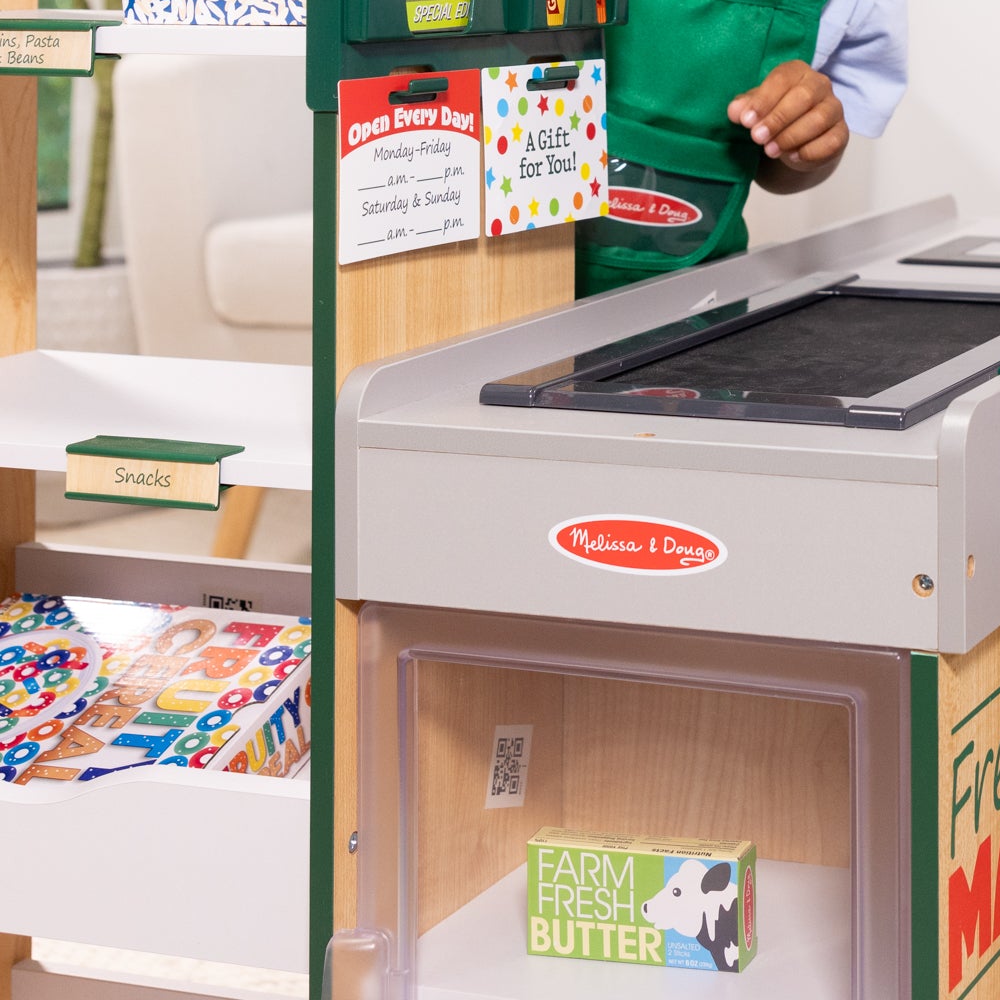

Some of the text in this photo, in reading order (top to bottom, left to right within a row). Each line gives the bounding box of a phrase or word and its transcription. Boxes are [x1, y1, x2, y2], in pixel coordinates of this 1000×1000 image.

[413, 2, 453, 23] SPECIAL
[0, 33, 60, 49] ins, Pasta
[7, 50, 45, 65] Beans
[348, 105, 474, 146] Open Every Day!
[525, 126, 570, 152] A Gift
[519, 150, 576, 179] for You!
[361, 186, 461, 216] Saturday & Sunday
[658, 203, 688, 223] Doug
[114, 467, 171, 488] Snacks
[569, 527, 643, 554] Melissa
[538, 848, 634, 889] FARM
[538, 882, 635, 923] FRESH
[530, 915, 662, 963] BUTTER
